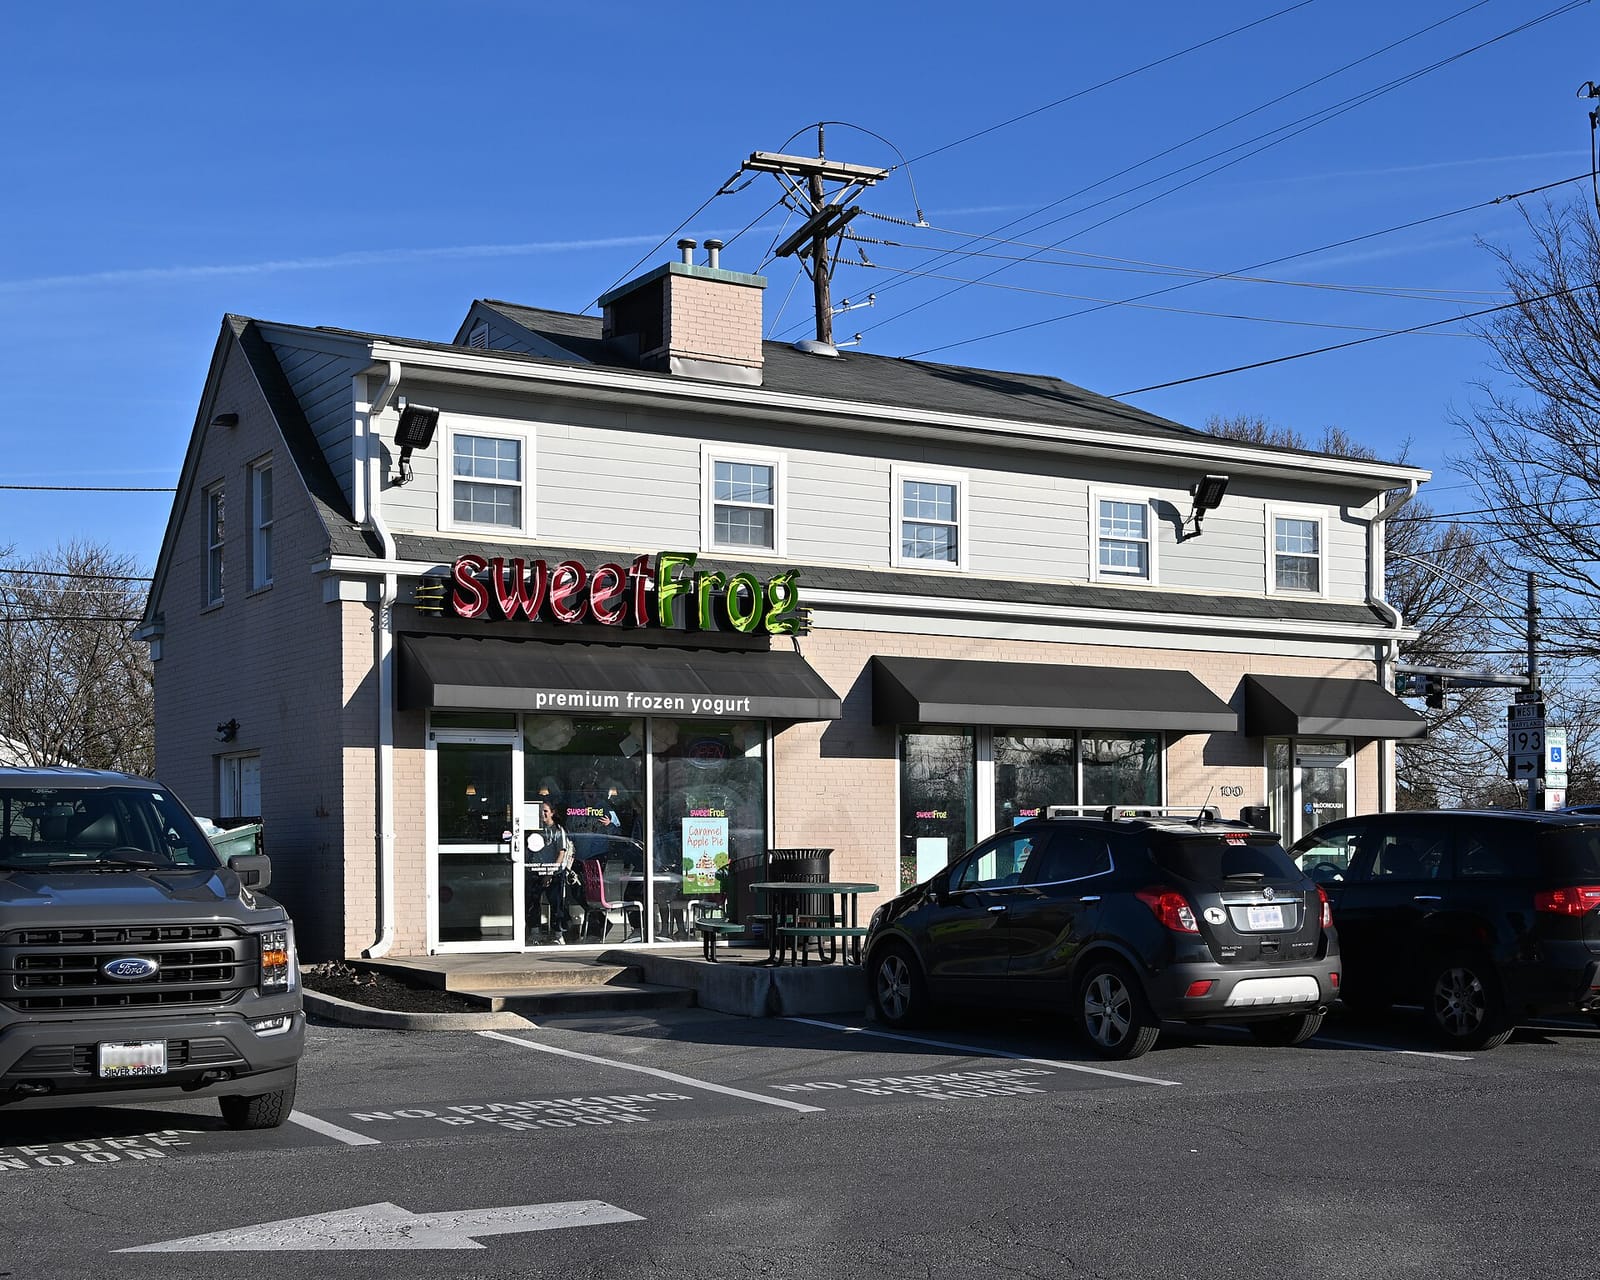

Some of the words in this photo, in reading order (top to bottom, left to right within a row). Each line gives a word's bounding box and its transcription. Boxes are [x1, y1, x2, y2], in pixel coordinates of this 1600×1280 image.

[452, 550, 801, 634] sweetFrog
[536, 691, 619, 709] premium
[626, 692, 685, 710] frozen
[691, 697, 750, 714] yogurt
[1516, 706, 1536, 717] WEST
[1511, 731, 1541, 751] 193
[688, 825, 722, 836] Caramel
[687, 836, 709, 848] Apple
[711, 836, 724, 846] Pie
[105, 1067, 130, 1077] SILVER
[132, 1066, 162, 1075] SPRING
[768, 1081, 848, 1093] NO
[847, 1068, 1057, 1087] PARKING
[851, 1078, 1041, 1096] BEFORE
[915, 1085, 1048, 1100] NOON
[348, 1109, 438, 1122] NO
[446, 1092, 694, 1114] PARKING
[434, 1103, 657, 1126] BEFORE
[497, 1113, 651, 1131] NOON
